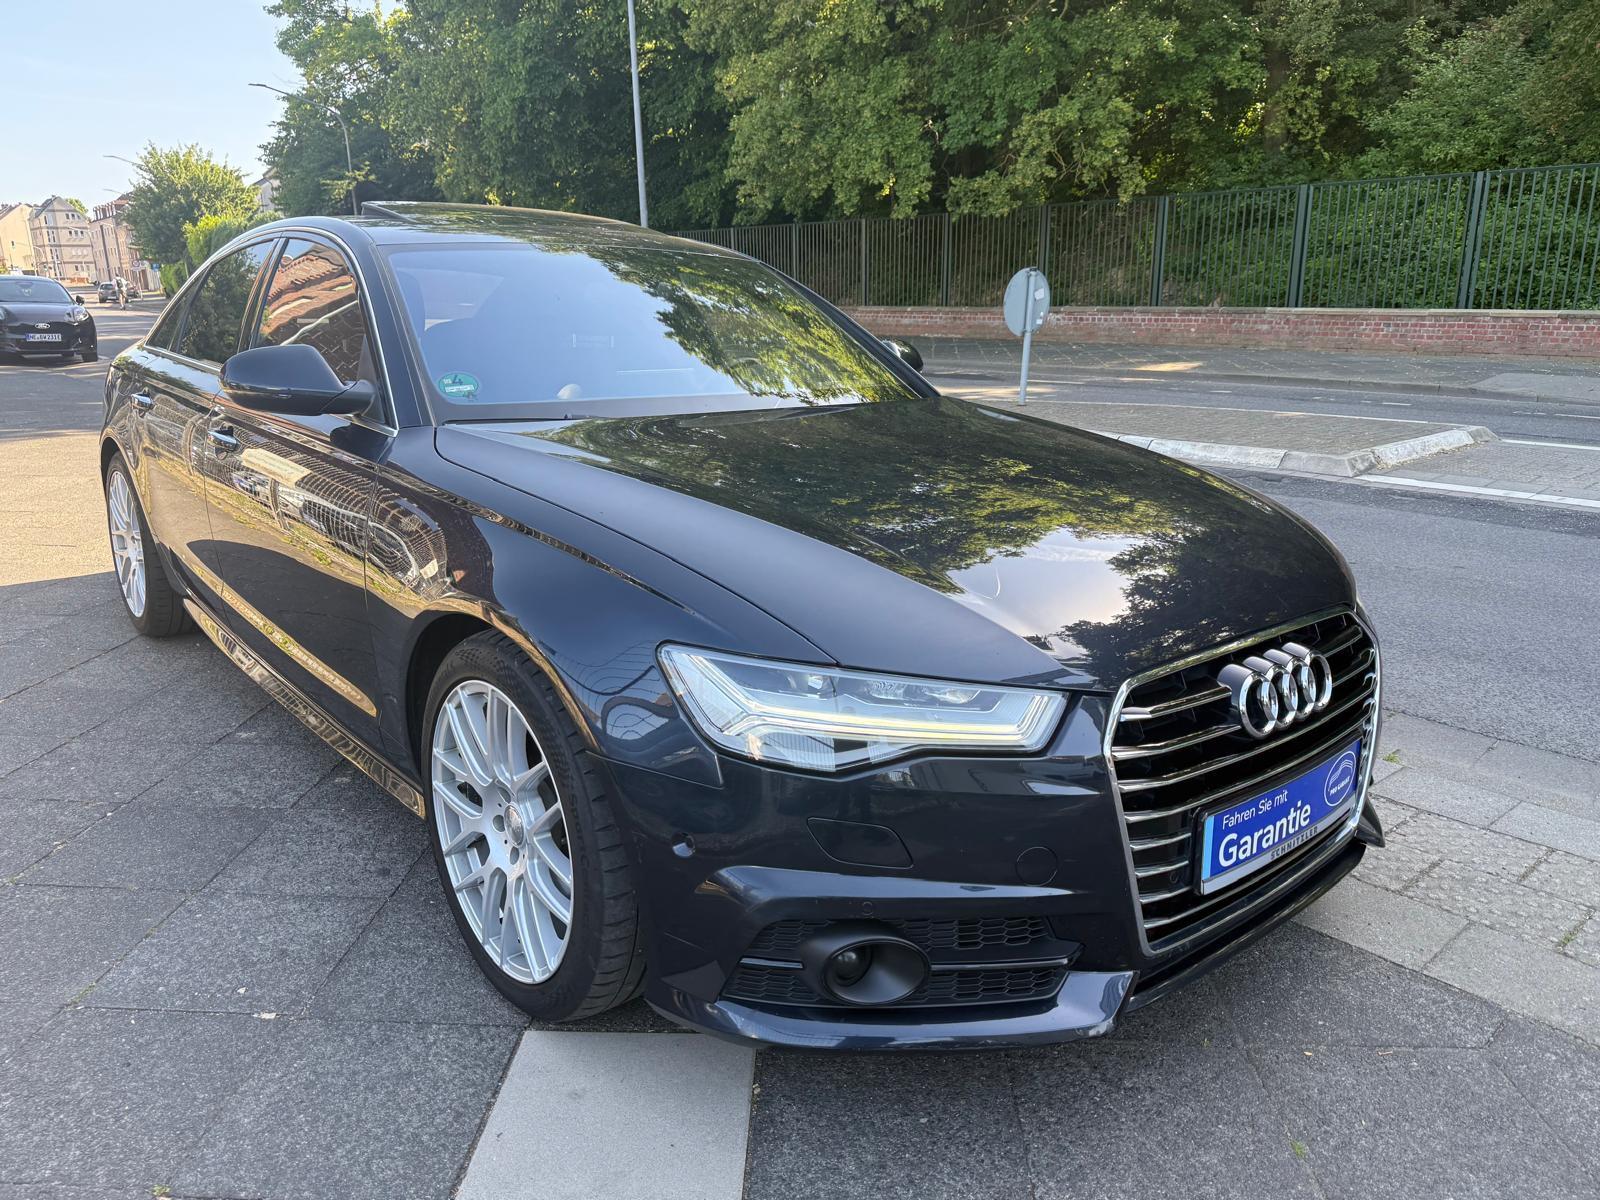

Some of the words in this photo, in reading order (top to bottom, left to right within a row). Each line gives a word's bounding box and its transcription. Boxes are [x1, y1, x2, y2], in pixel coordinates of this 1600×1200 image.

[1222, 807, 1256, 830] Fahren
[1258, 797, 1273, 814] Sie
[1274, 789, 1289, 808] mit
[1218, 799, 1311, 868] Garantie
[1270, 825, 1318, 861] SCHNITZLER
